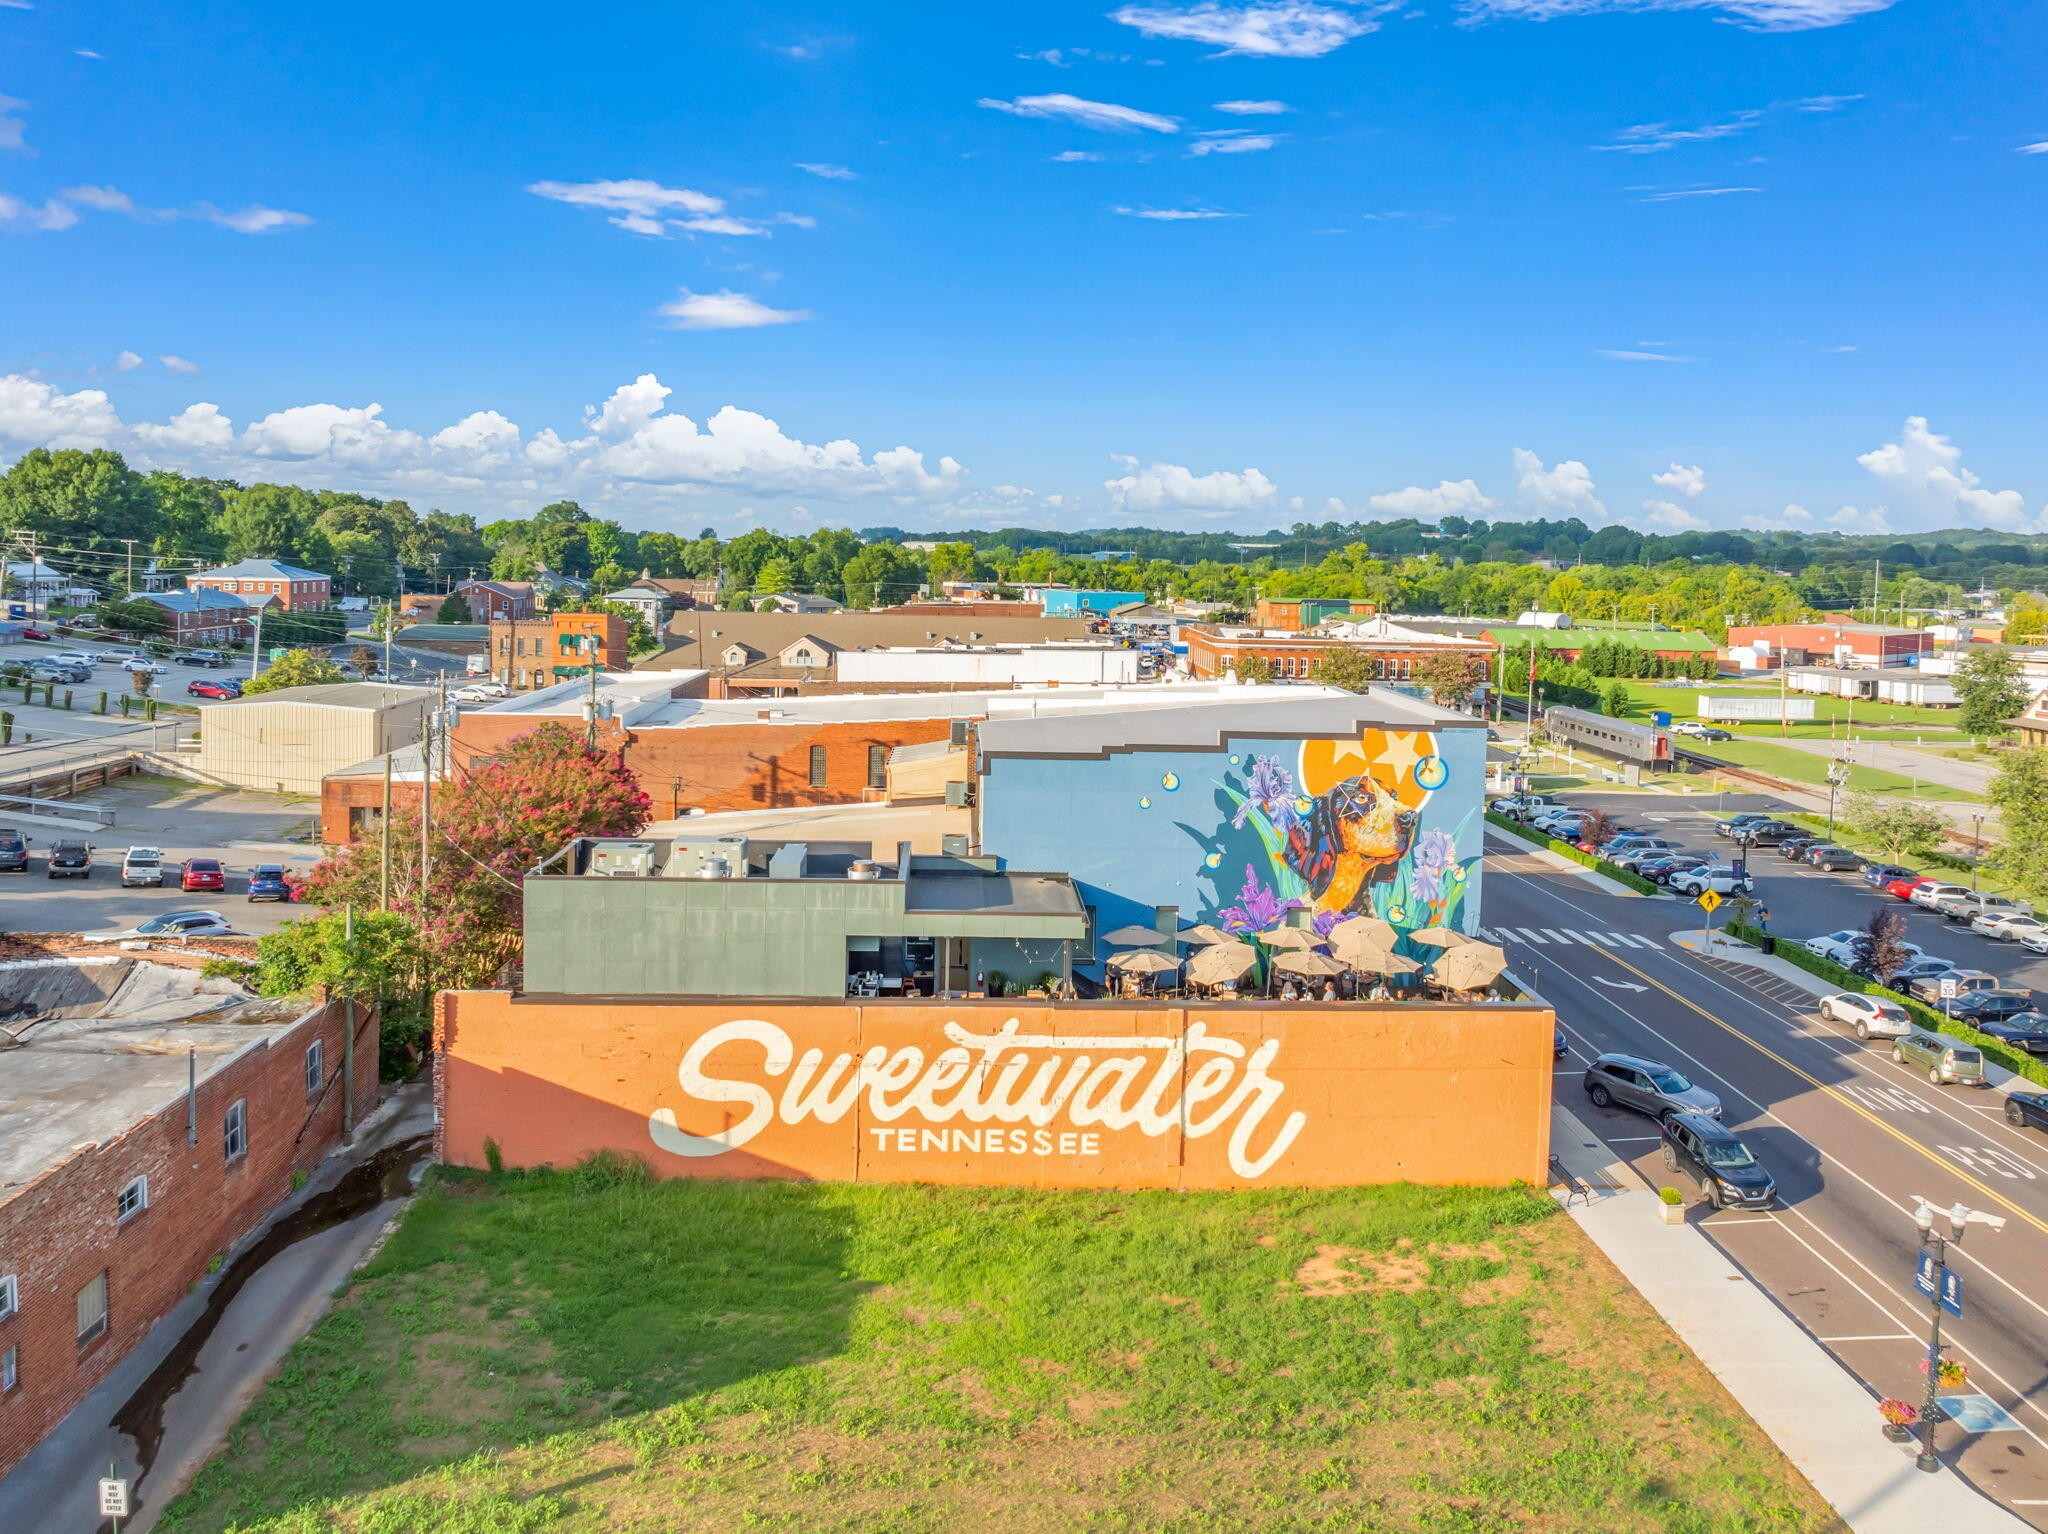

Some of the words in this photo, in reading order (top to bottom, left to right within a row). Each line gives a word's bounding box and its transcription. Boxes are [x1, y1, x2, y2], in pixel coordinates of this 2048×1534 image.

[1943, 988, 1953, 996] 30
[649, 1018, 1306, 1179] Sweetwater
[1836, 1085, 1931, 1114] XING
[870, 1129, 1101, 1155] TENNESSEE
[1936, 1145, 2037, 1179] PED
